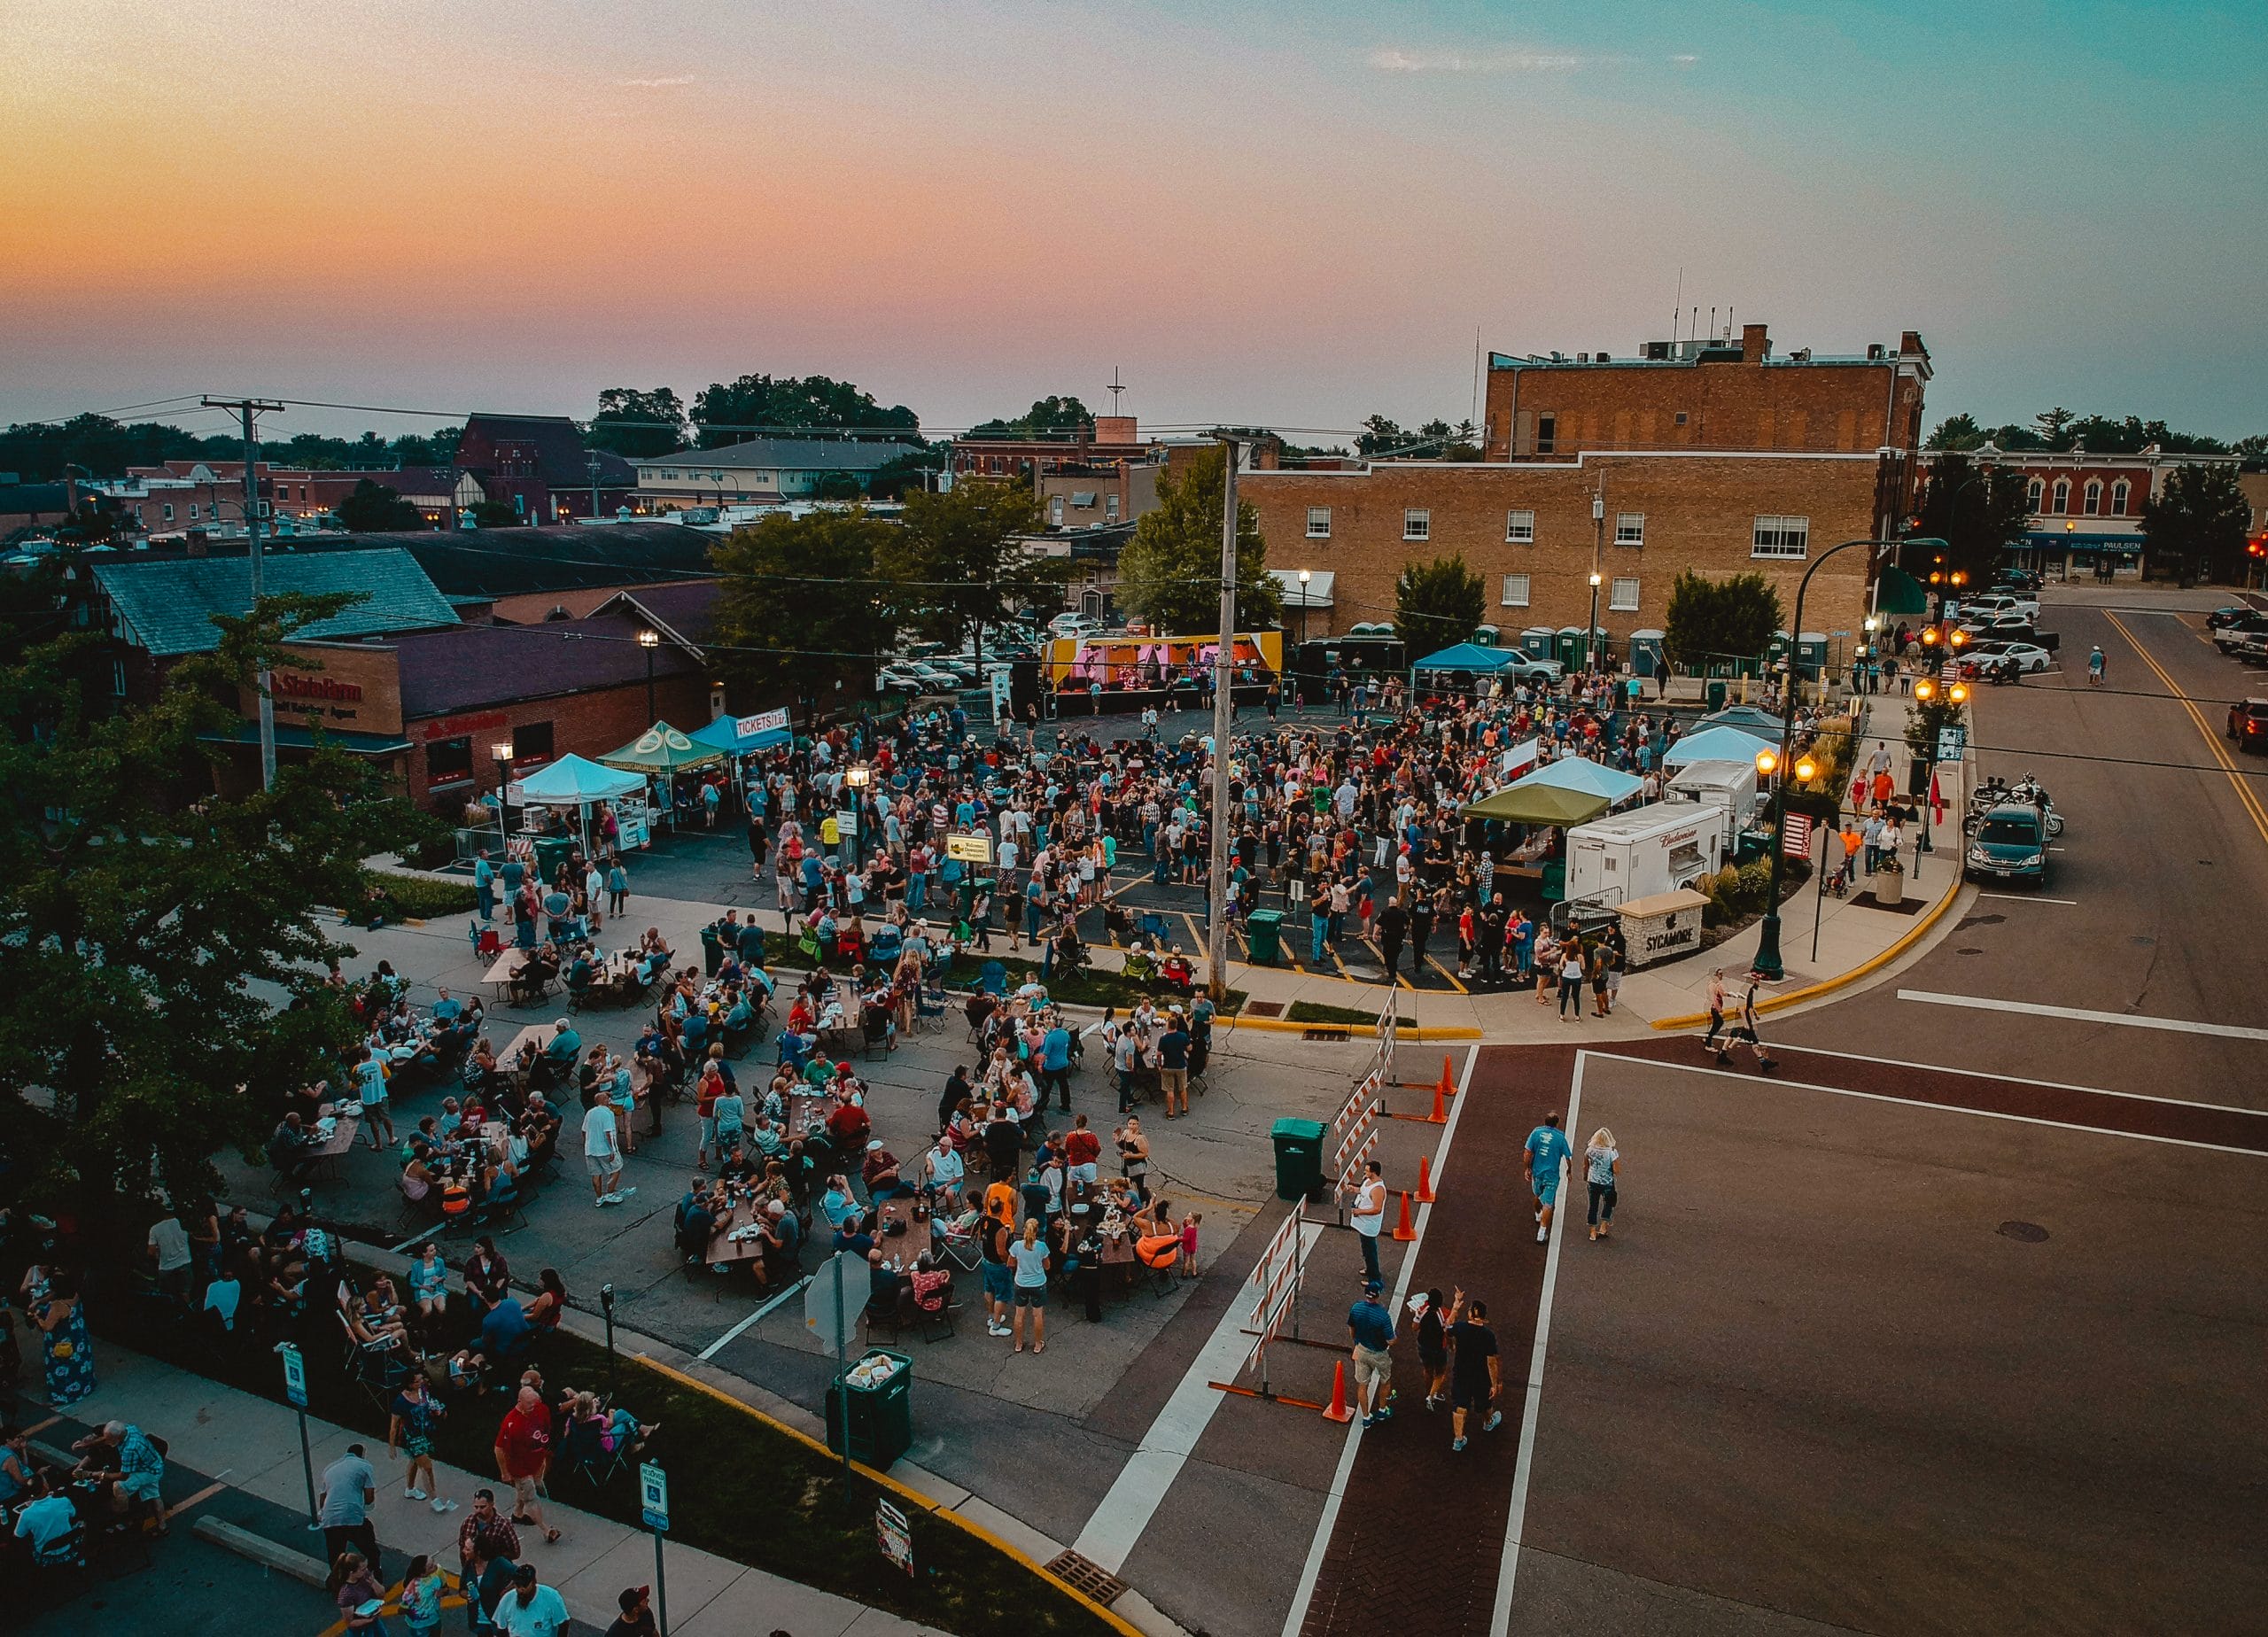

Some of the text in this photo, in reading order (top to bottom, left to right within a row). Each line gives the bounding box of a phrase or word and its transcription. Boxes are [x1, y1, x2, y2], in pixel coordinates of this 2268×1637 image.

[1659, 828, 1698, 849] Budweiser
[1802, 817, 1812, 857] SYCAMORE
[1645, 927, 1693, 952] SYCAMORE
